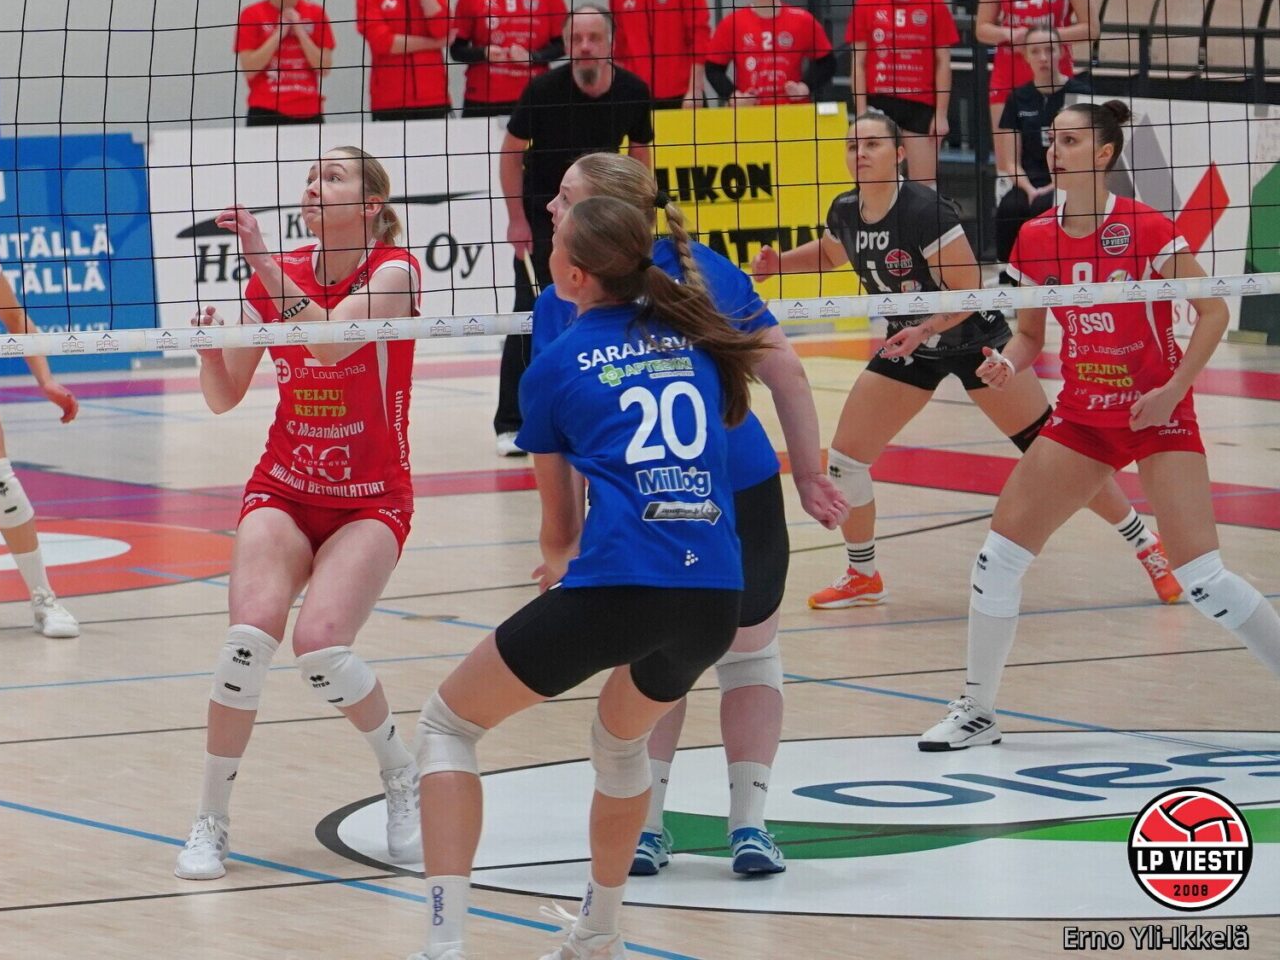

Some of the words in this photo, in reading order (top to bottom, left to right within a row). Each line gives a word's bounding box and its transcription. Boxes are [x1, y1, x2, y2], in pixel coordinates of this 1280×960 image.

[762, 31, 773, 50] 2
[425, 232, 483, 279] Oy
[1080, 311, 1116, 335] SSO
[294, 367, 309, 379] OP
[619, 380, 708, 465] 20
[635, 466, 711, 497] Millog
